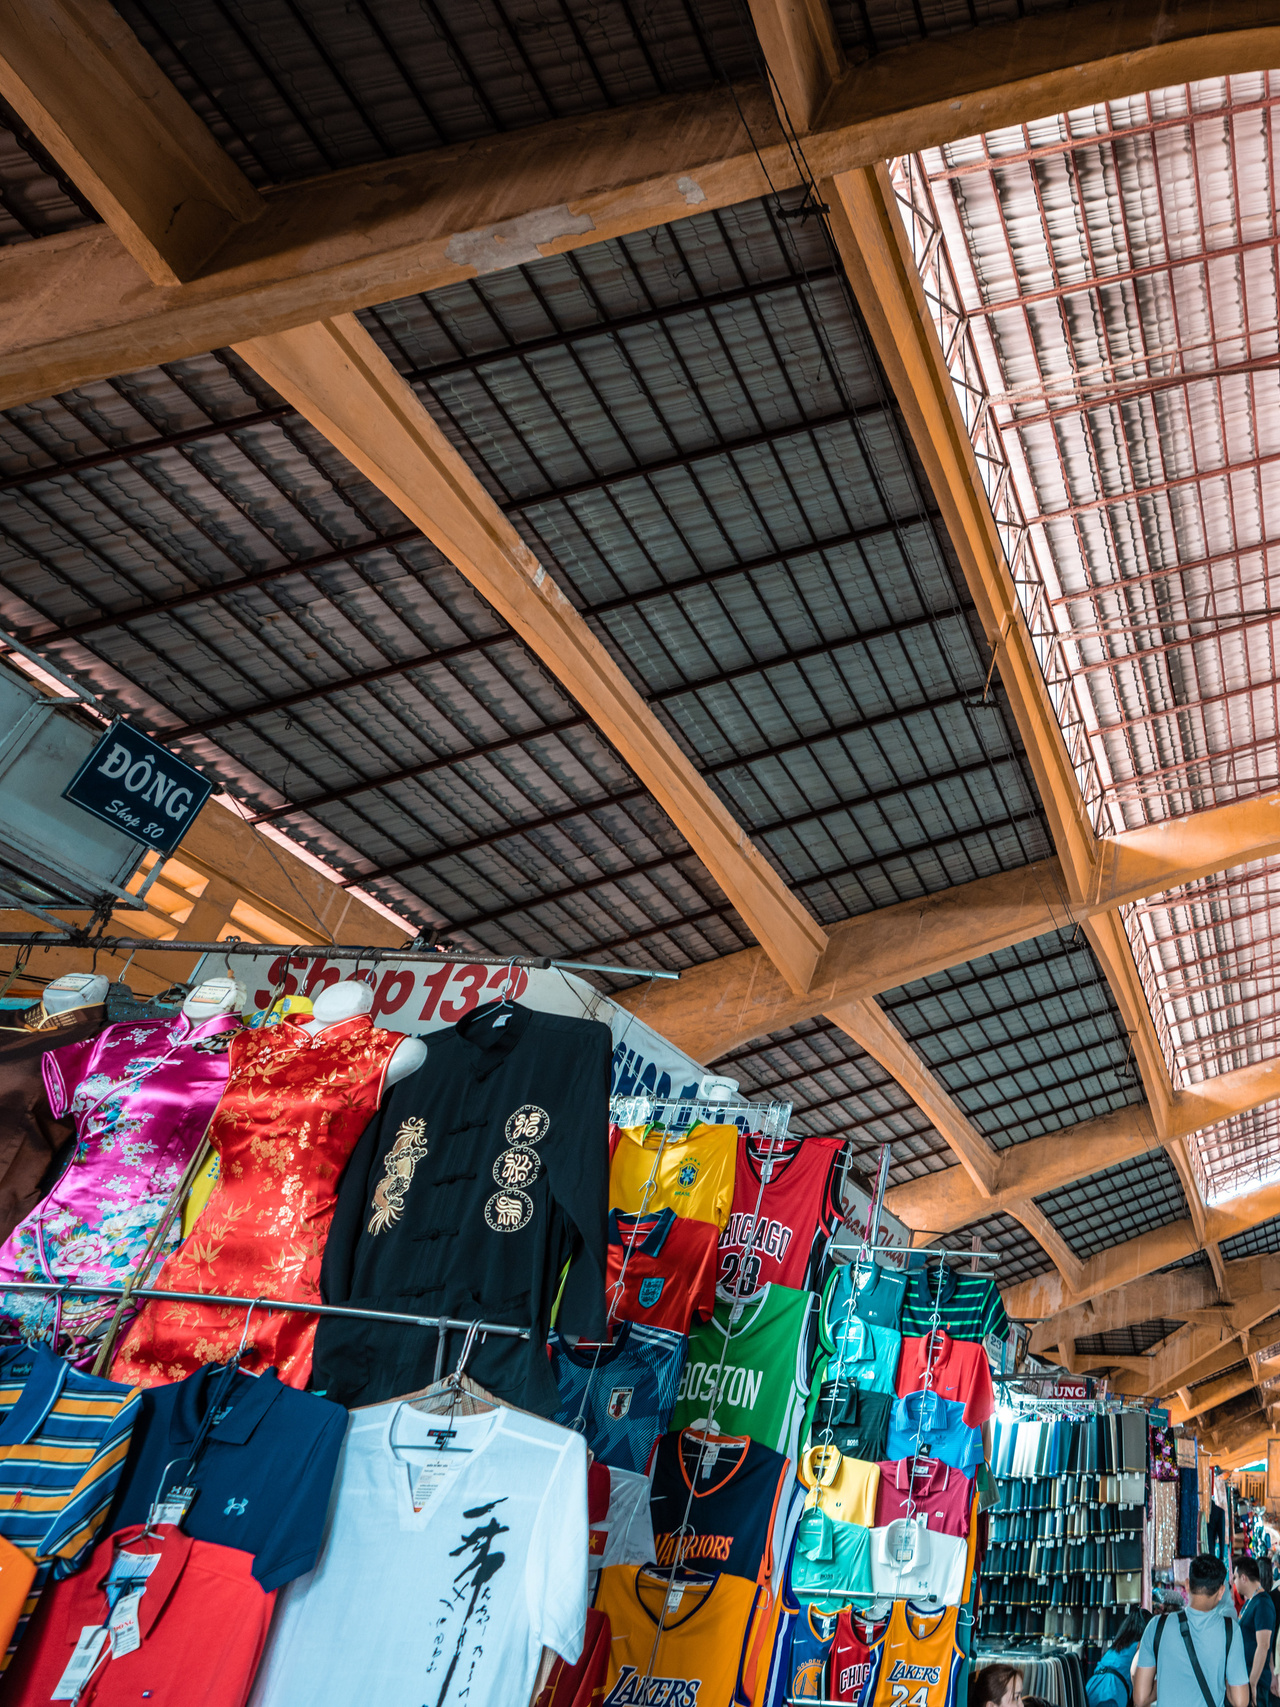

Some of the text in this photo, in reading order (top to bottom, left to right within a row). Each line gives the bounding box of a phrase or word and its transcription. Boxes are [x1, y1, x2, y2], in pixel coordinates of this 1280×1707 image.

[97, 742, 194, 821] ĐÔNG
[105, 800, 165, 838] Shop 80
[718, 1212, 793, 1264] HICAGO
[719, 1252, 762, 1297] 23
[677, 1362, 763, 1411] BOSTON
[1051, 1386, 1087, 1398] UNG
[797, 1659, 821, 1671] GOLDEN
[840, 1663, 870, 1694] CHIC
[886, 1659, 942, 1685] LAKERS
[602, 1664, 702, 1707] LAKERS
[890, 1684, 929, 1707] 24
